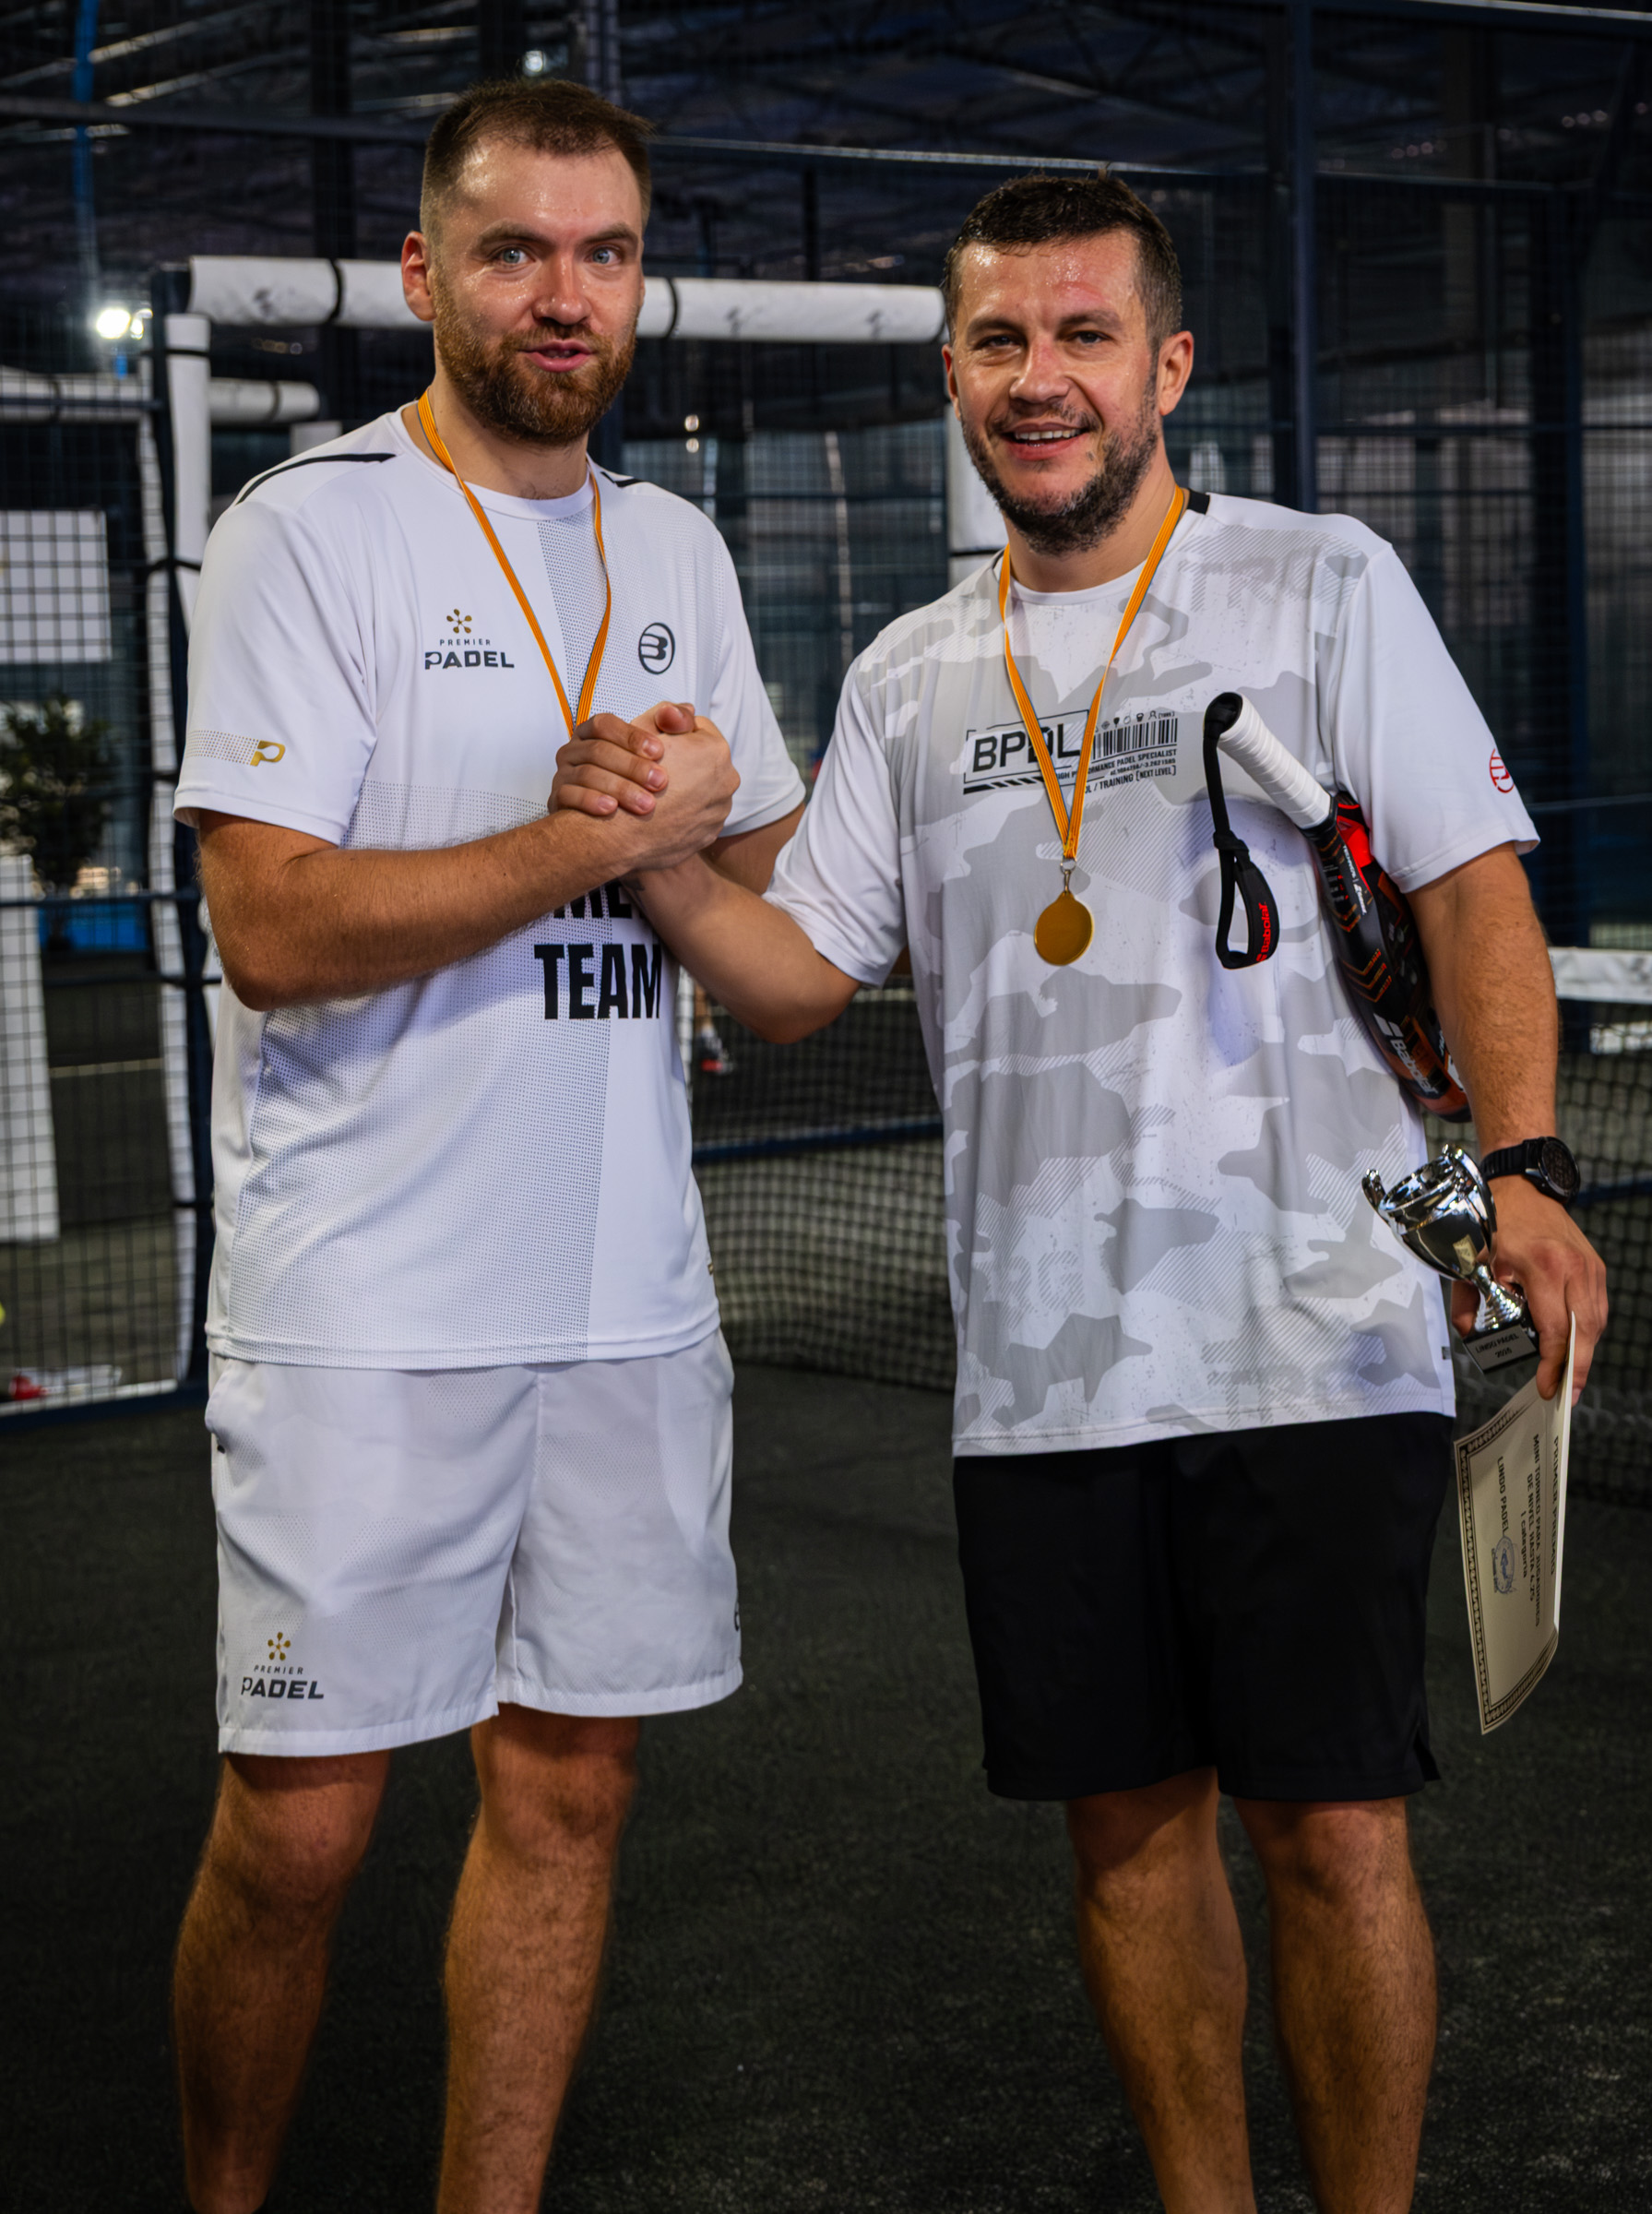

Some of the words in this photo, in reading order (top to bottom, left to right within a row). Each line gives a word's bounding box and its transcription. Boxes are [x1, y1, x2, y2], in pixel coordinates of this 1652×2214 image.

[424, 650, 515, 670] PADEL
[1116, 756, 1135, 768] PADEL
[1137, 748, 1177, 762] SPECIALIST
[1099, 774, 1134, 790] TRAINING
[533, 944, 662, 1019] TEAM
[1497, 1456, 1506, 1494] LINDO
[1527, 1472, 1534, 1493] DE
[1500, 1495, 1509, 1536] PADEL
[254, 1664, 303, 1675] PREMIER
[241, 1676, 325, 1699] PADEL
